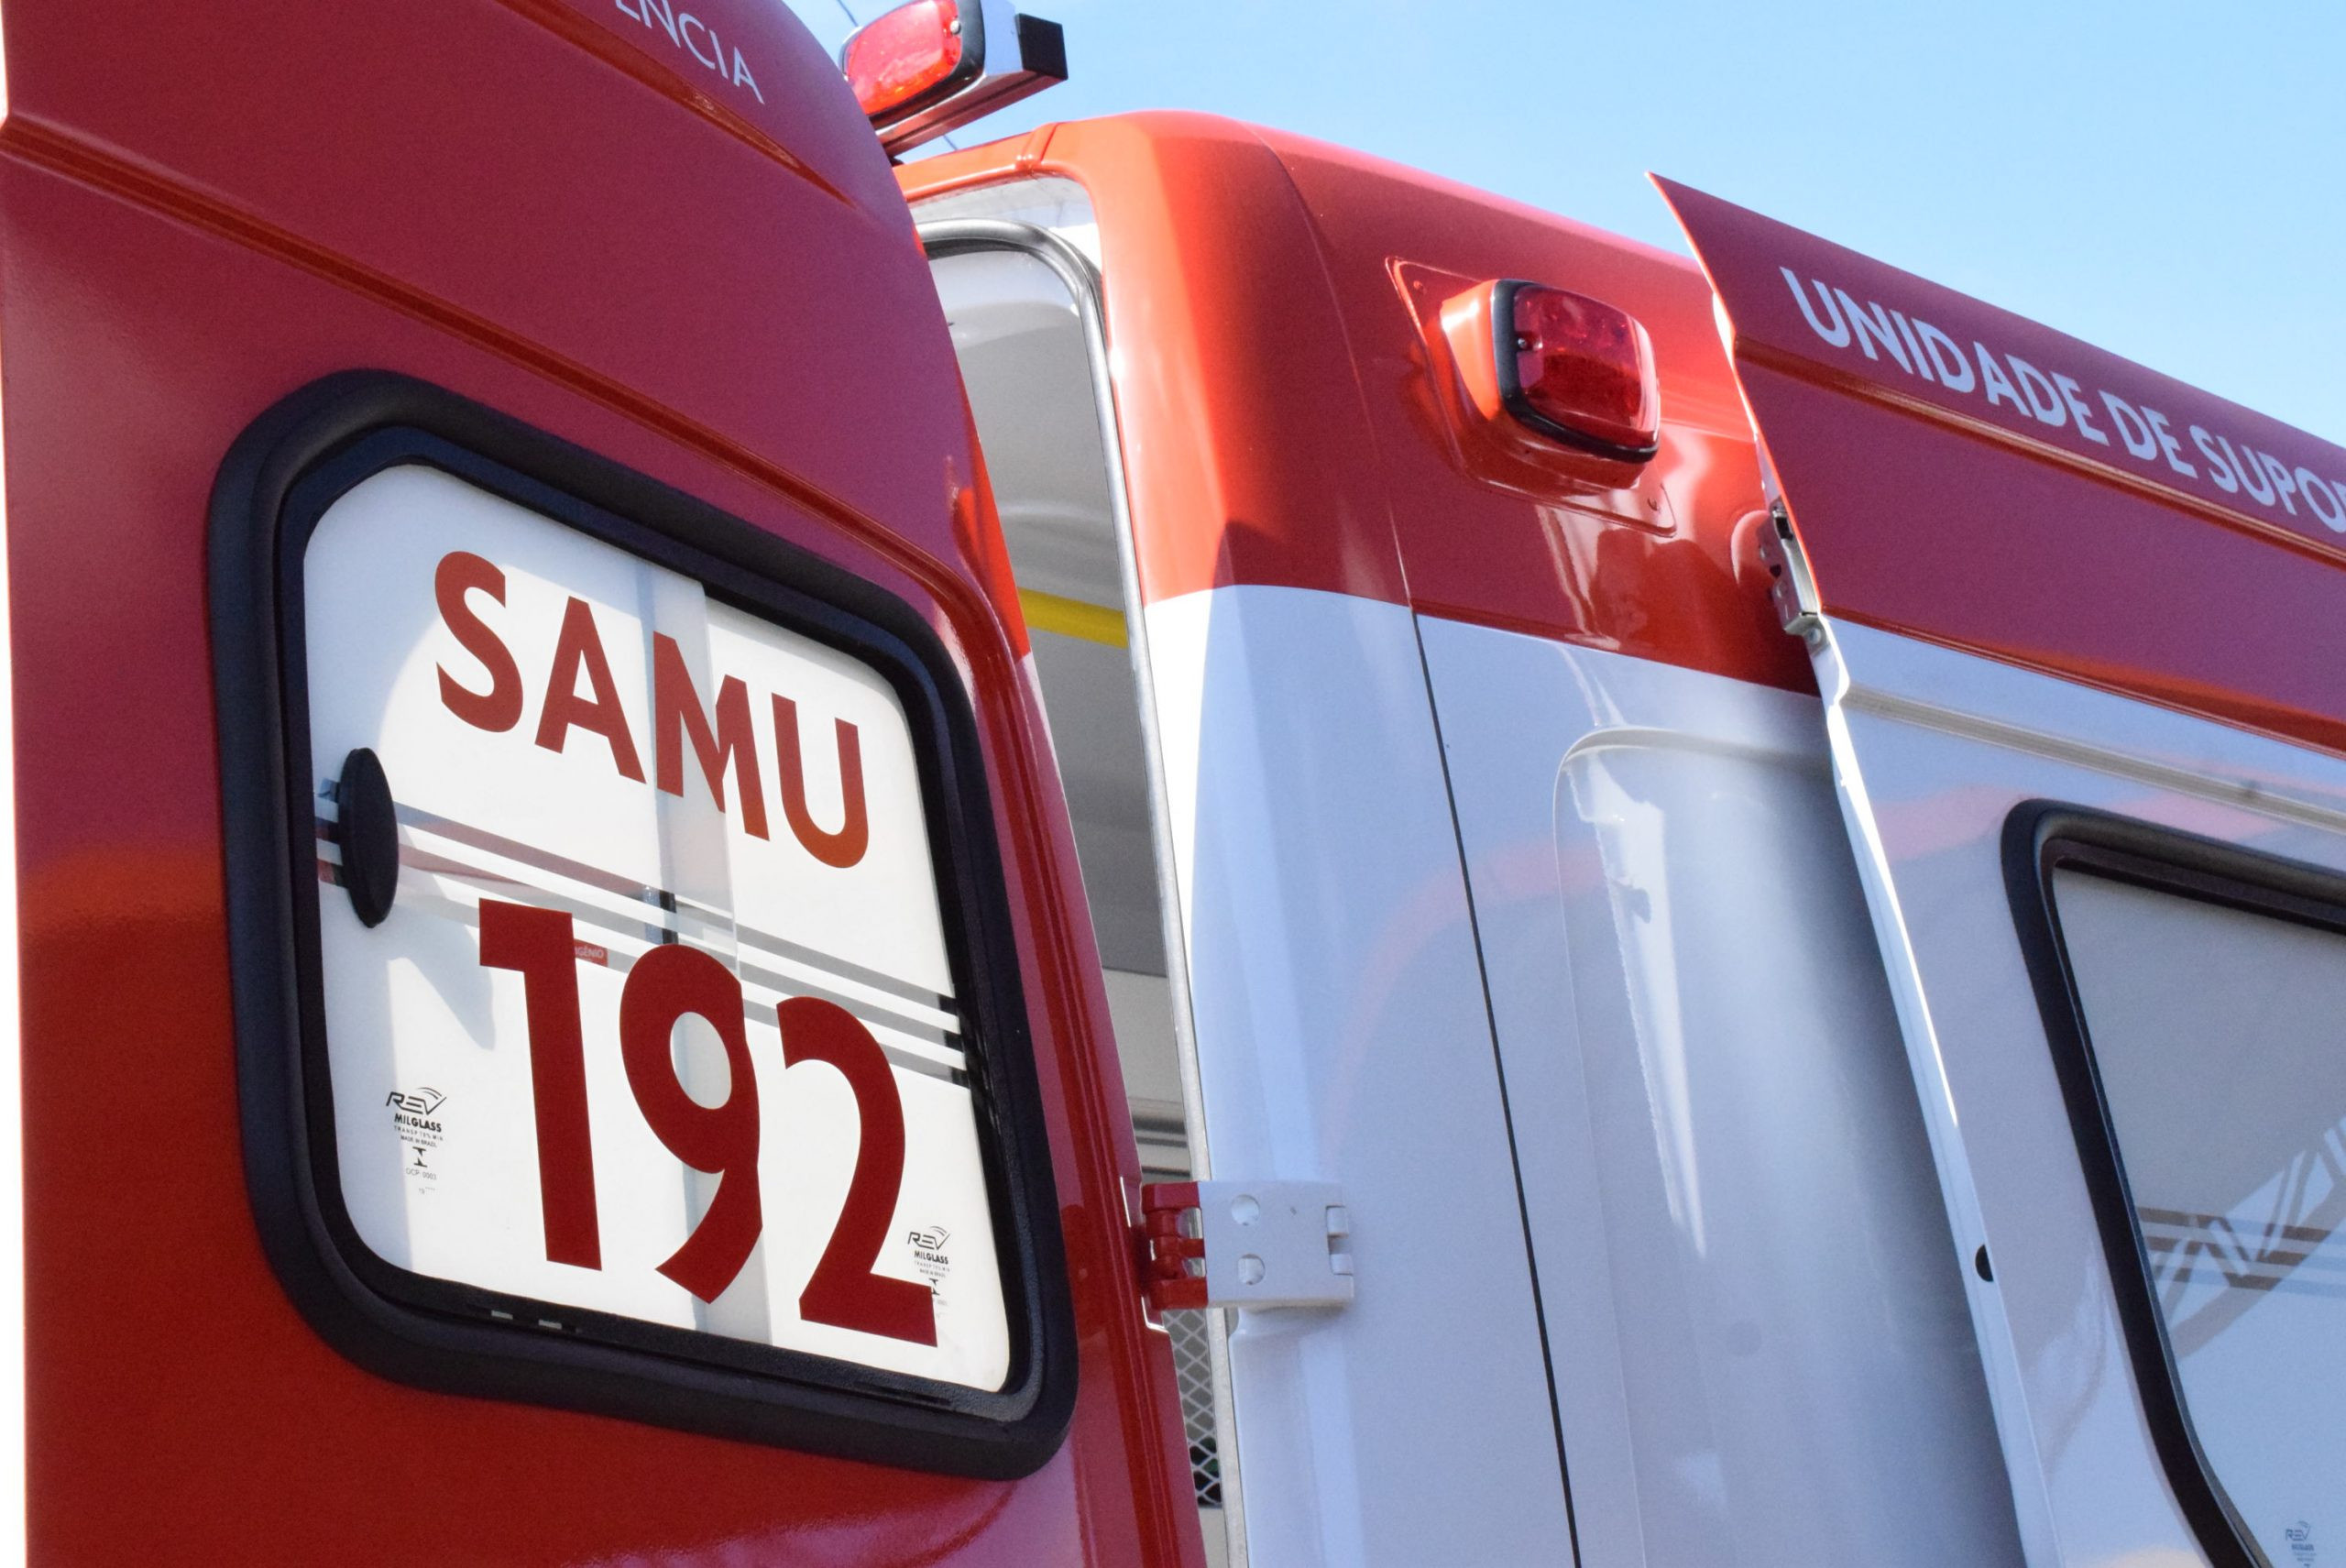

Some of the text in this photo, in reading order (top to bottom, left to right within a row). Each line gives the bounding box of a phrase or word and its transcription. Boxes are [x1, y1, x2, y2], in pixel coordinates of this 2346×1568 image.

[615, 0, 765, 105] NCIA
[1779, 266, 2110, 447] UNIDADE
[2099, 389, 2198, 479] DE
[433, 550, 870, 869] SAMU
[386, 1091, 447, 1115] REV
[394, 1113, 442, 1133] MILGLASS
[477, 897, 938, 1348] 192
[400, 1135, 413, 1143] MADE
[421, 1139, 438, 1148] BRAZIL
[907, 1231, 950, 1251] REV
[914, 1250, 949, 1265] MILGLASS
[2286, 1525, 2311, 1541] REV
